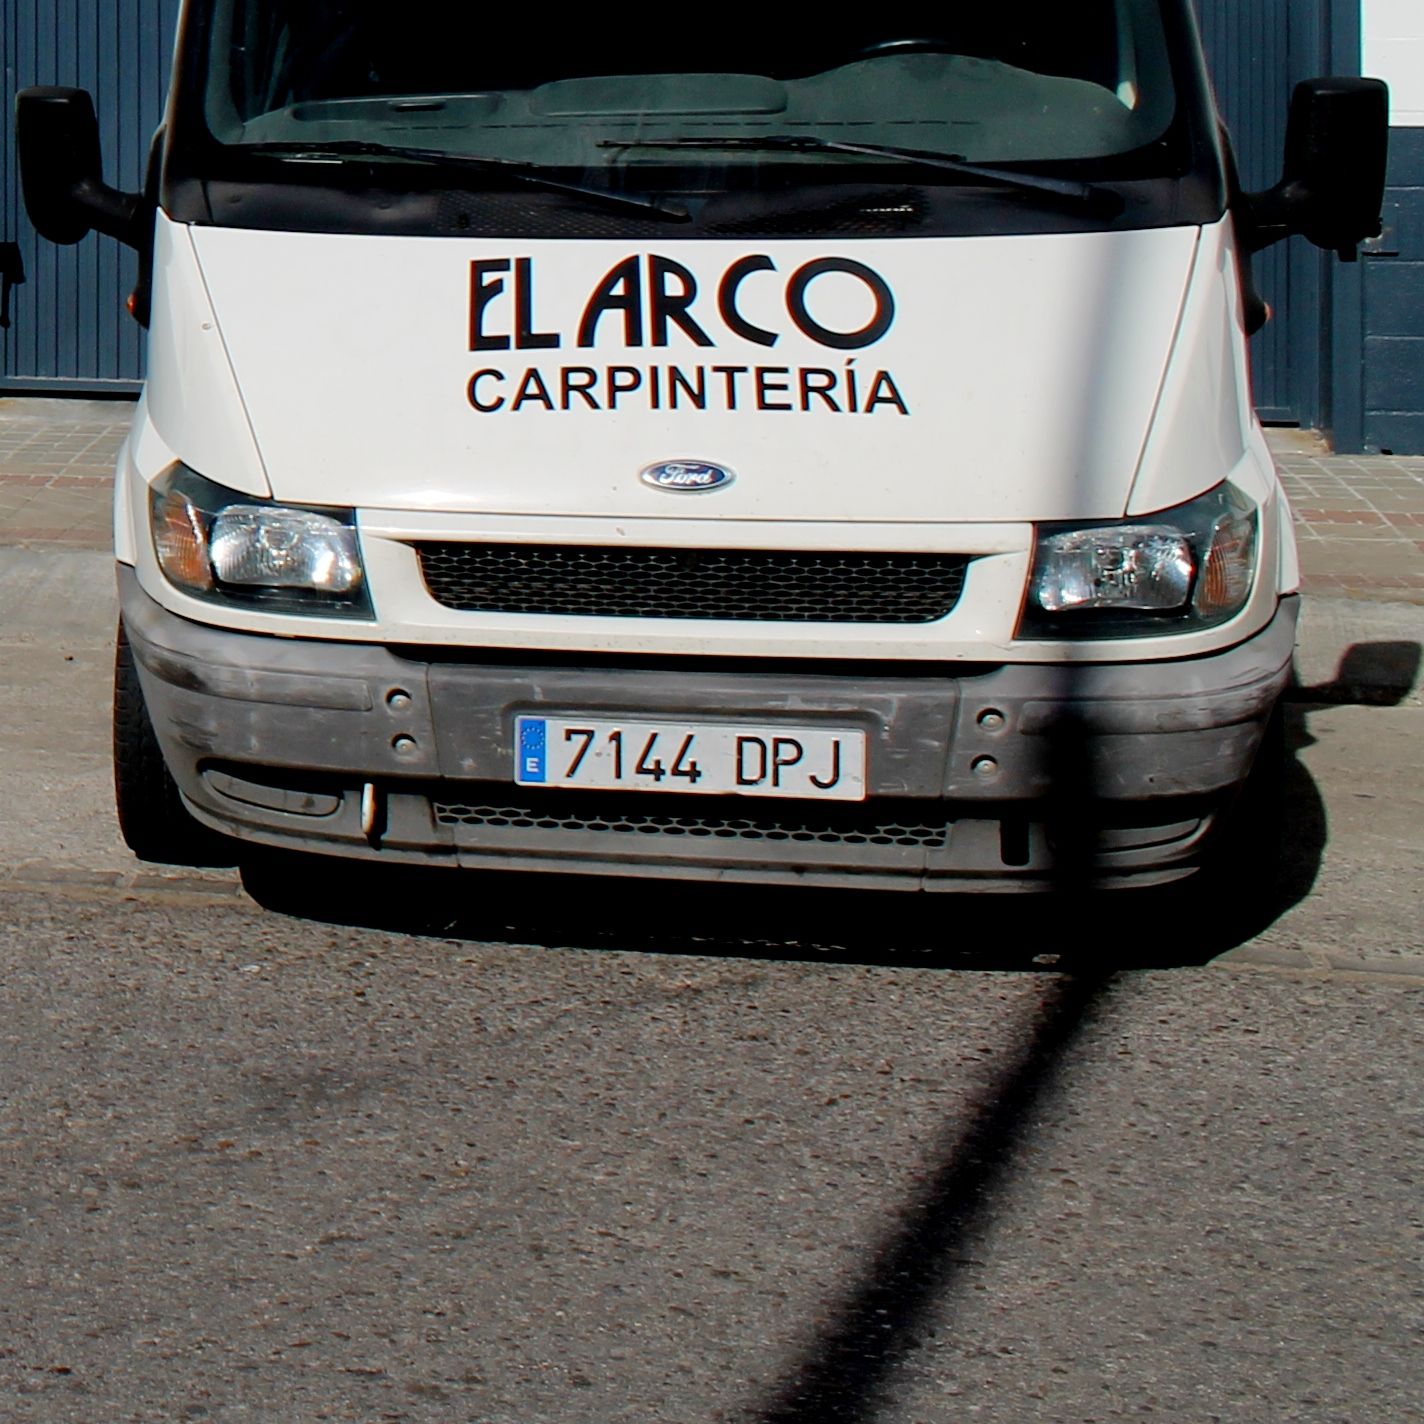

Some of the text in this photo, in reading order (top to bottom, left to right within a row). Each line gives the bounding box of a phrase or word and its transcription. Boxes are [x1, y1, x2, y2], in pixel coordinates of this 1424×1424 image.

[468, 253, 896, 352] EL ARCO
[466, 358, 911, 416] CARPINTERÍA
[657, 461, 714, 486] Ford
[525, 727, 841, 789] E 7144 DPJ
